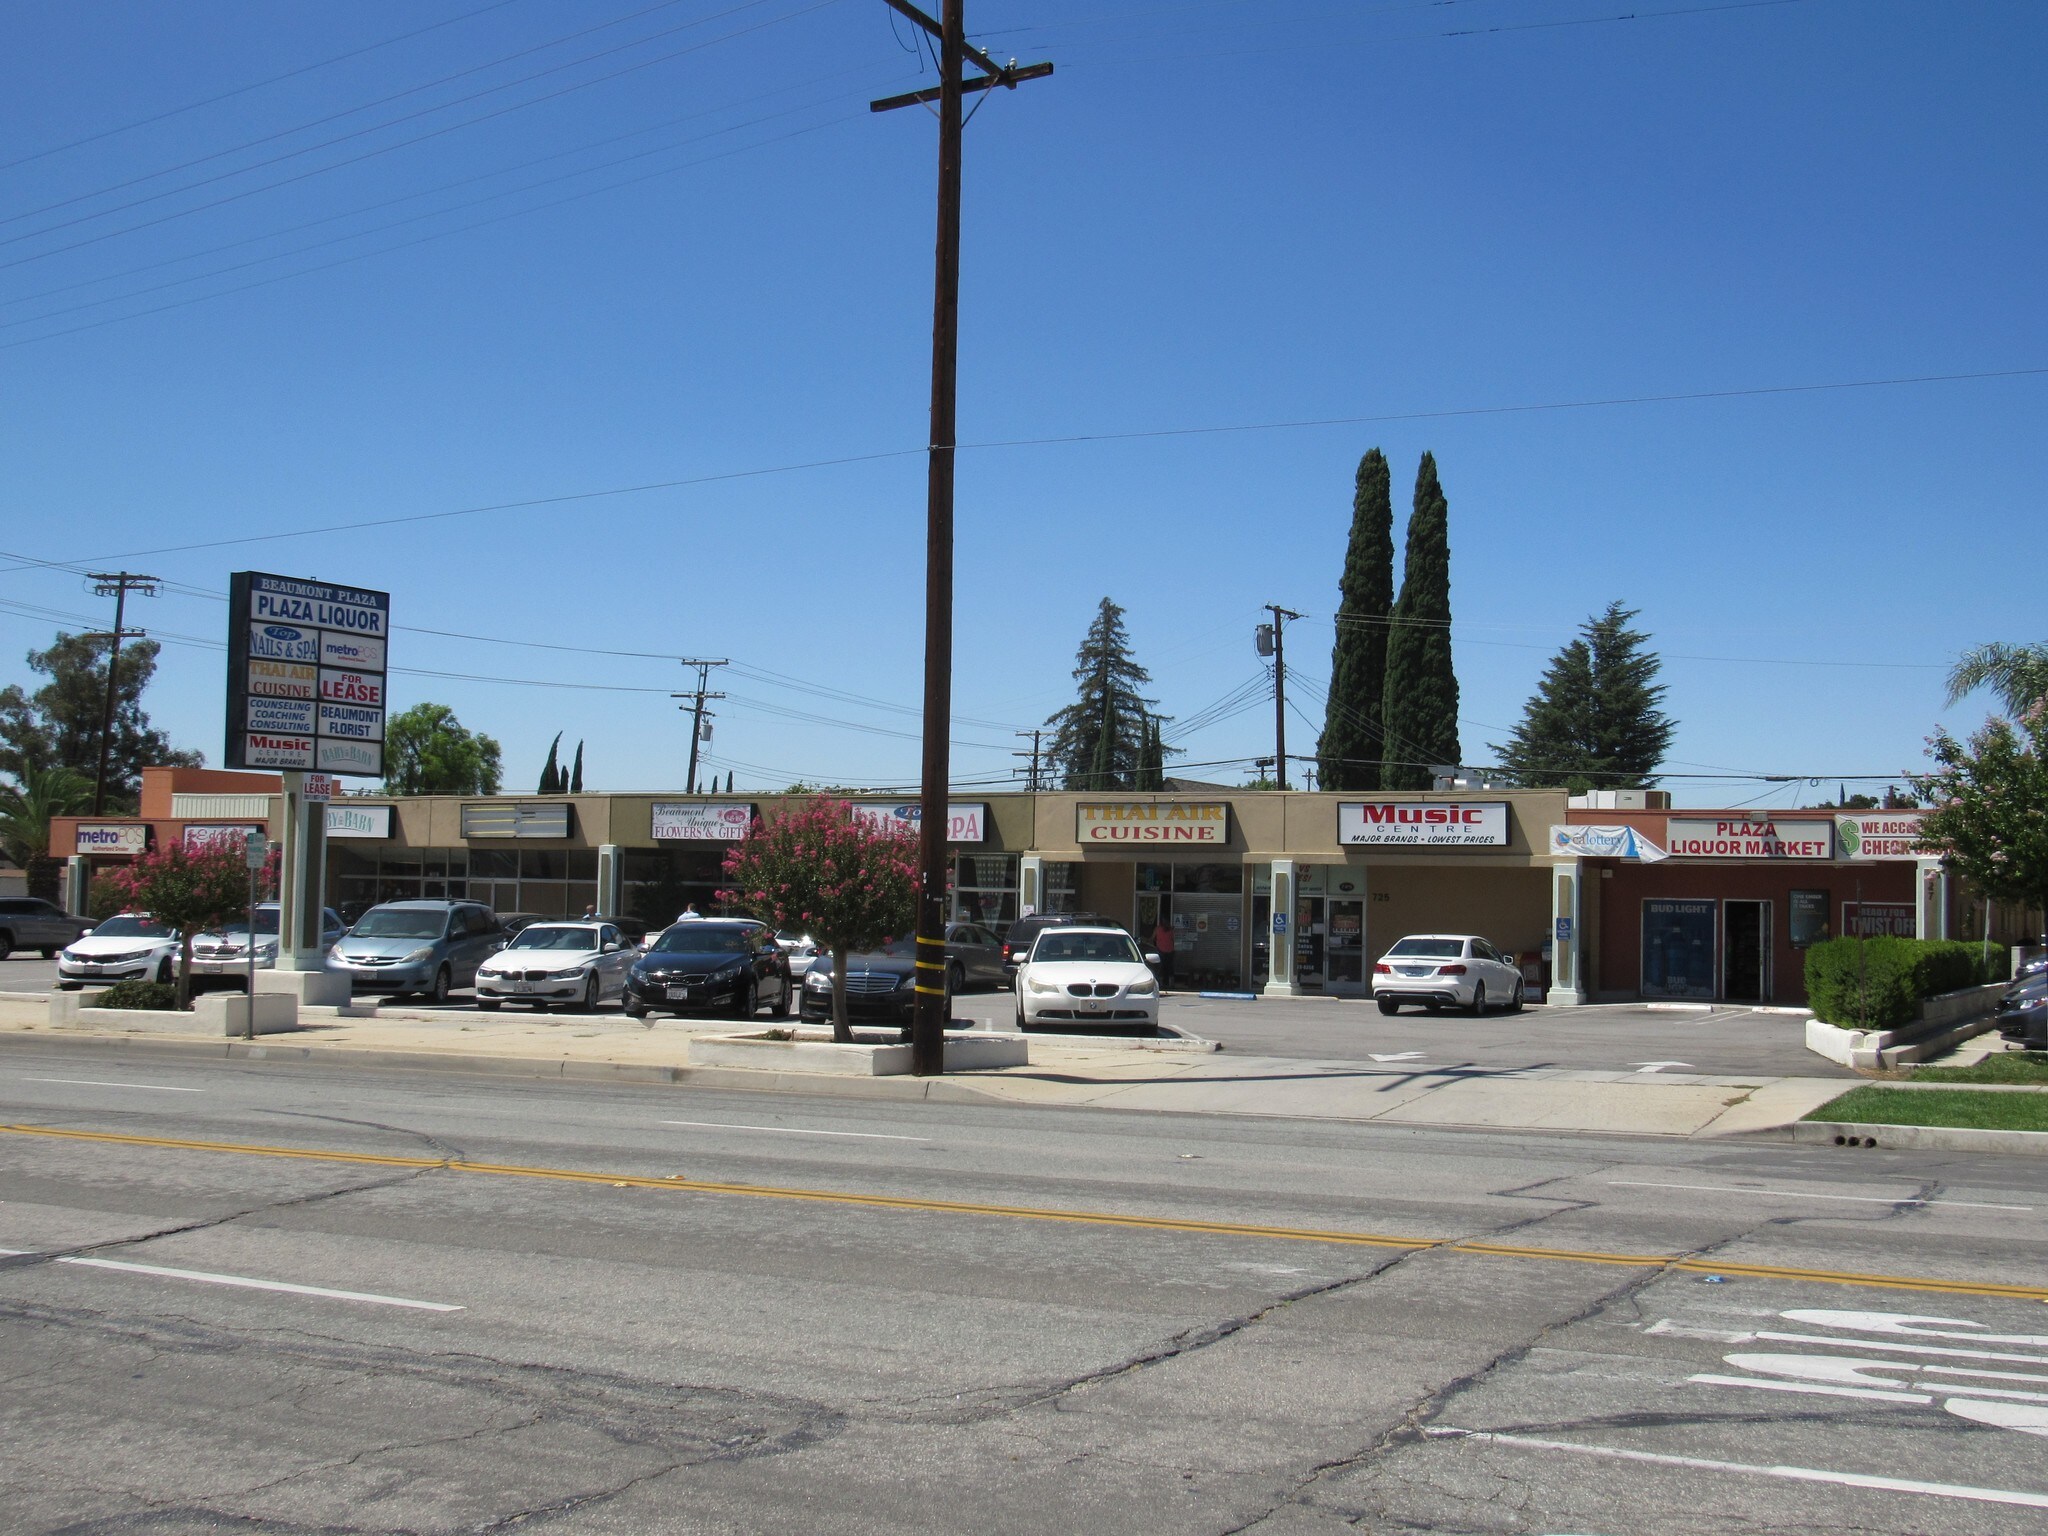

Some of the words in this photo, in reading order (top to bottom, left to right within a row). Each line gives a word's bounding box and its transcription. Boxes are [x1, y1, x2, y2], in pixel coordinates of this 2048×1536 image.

[261, 578, 332, 600] BEAUMONT
[337, 590, 377, 607] PLAZA
[258, 595, 313, 621] PLAZA
[318, 603, 380, 631] LIQUOR
[270, 627, 296, 640] Top
[250, 631, 283, 657] NAILS
[285, 642, 293, 658] &
[296, 638, 318, 660] SPA
[326, 644, 377, 660] metroPCS
[249, 661, 286, 677] THAI
[290, 665, 316, 680] AIR
[341, 674, 362, 683] FOR
[253, 681, 311, 697] CUISINE
[322, 680, 379, 702] LEASE
[250, 699, 311, 711] COUNSELING
[255, 709, 306, 721] COACHING
[321, 706, 380, 723] BEAUMONT
[250, 720, 310, 731] CONSULTING
[329, 721, 371, 736] FLORIST
[250, 735, 312, 751] Music
[258, 749, 302, 757] CENTRE
[254, 757, 278, 766] MAJOR
[279, 758, 306, 767] BRANDS
[310, 774, 325, 783] FOR
[304, 783, 330, 795] LEASE
[655, 805, 707, 817] Beaumont
[900, 806, 921, 817] To
[1080, 804, 1158, 820] THAI
[1164, 804, 1224, 820] AIR
[1362, 804, 1483, 824] Music
[345, 811, 375, 833] BARN
[946, 813, 979, 839] PA
[1376, 825, 1472, 833] CENTRE
[1716, 822, 1777, 837] PLAZA
[1861, 822, 1880, 834] WE
[1882, 822, 1916, 834] ACCE
[77, 827, 144, 844] metroPCS
[655, 826, 702, 838] FLOWERS
[705, 826, 714, 838] &
[718, 826, 744, 838] GIFT
[1090, 826, 1214, 840] CUISINE
[1383, 835, 1419, 843] BRANDS
[1427, 836, 1461, 844] LOWEST
[1463, 836, 1495, 844] PRICES
[1572, 832, 1624, 849] calottery
[1671, 840, 1741, 855] LIQUOR
[1745, 841, 1825, 856] MARKET
[1861, 840, 1911, 855] CHECK
[1650, 904, 1674, 913] BUD
[1675, 904, 1708, 914] LIGHT
[1861, 908, 1887, 917] READY
[1889, 908, 1906, 917] FOR
[1850, 917, 1892, 934] TWIST
[1894, 918, 1916, 935] OFF
